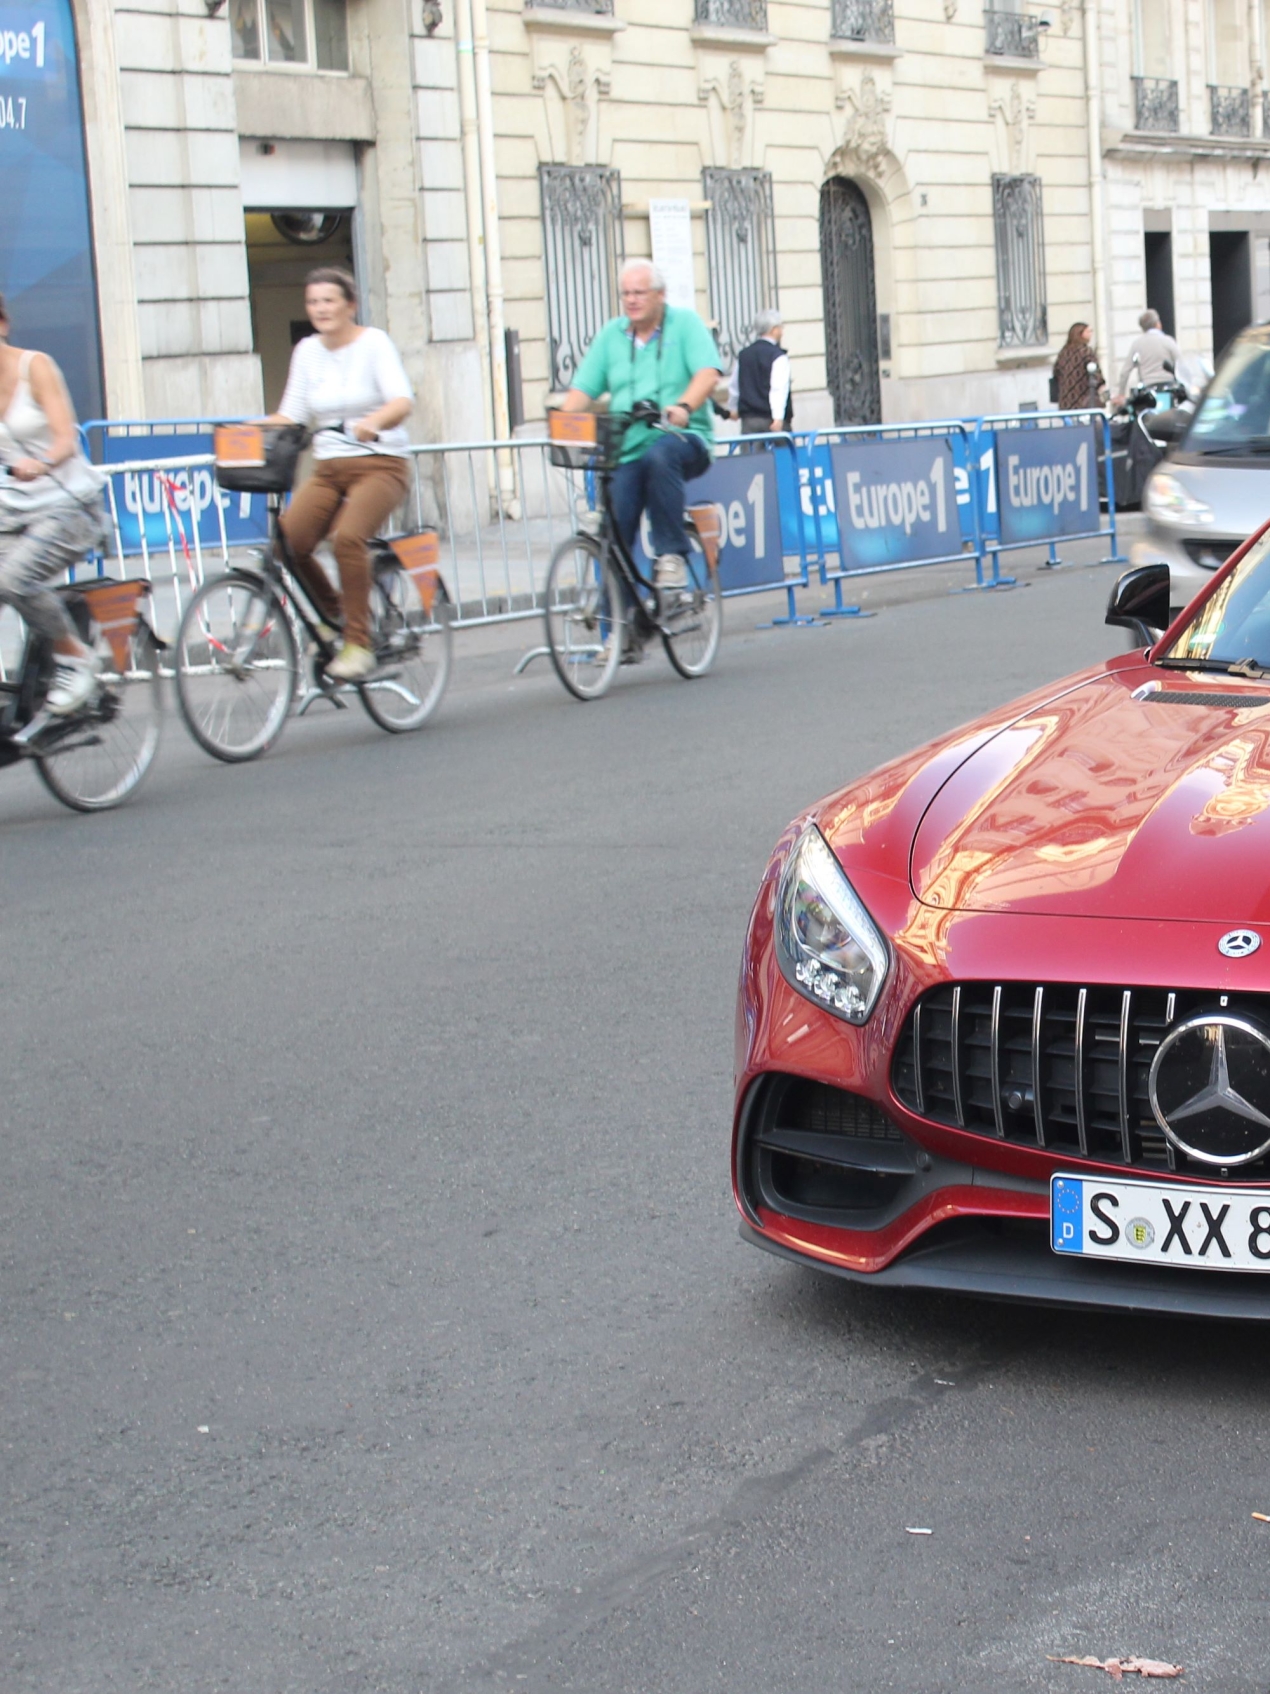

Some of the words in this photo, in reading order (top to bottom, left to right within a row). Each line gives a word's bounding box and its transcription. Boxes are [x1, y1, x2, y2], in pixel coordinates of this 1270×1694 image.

[1063, 1223, 1074, 1238] D
[1088, 1192, 1120, 1245] S
[1160, 1198, 1232, 1258] XX
